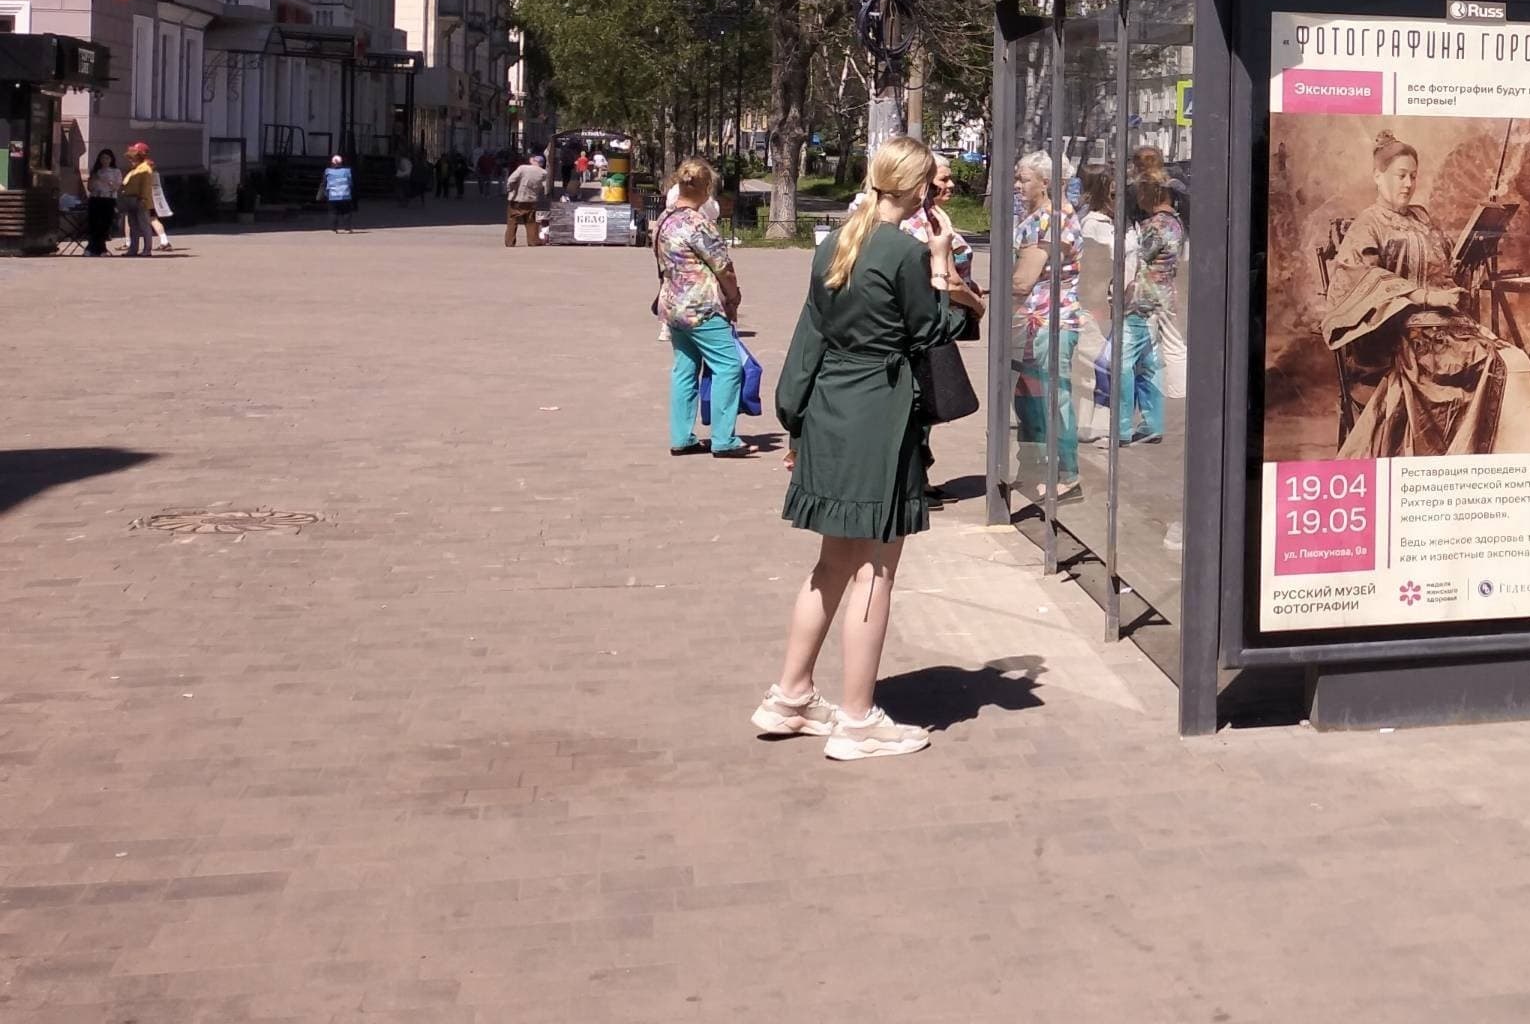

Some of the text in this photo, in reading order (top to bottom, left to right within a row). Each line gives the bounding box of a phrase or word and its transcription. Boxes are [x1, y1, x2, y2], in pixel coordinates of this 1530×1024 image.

[1468, 3, 1504, 18] Russ
[1294, 82, 1372, 97] Эксклюзив
[1407, 84, 1426, 93] все
[1428, 84, 1494, 95] фотографии
[1496, 85, 1526, 96] будут
[1407, 96, 1457, 107] впервые!
[1401, 466, 1468, 478] Реставрация
[1470, 465, 1527, 476] проведена
[1285, 473, 1367, 501] 19.04
[1401, 480, 1502, 493] фармацевтической
[1401, 497, 1444, 508] Рихтер»
[1455, 497, 1492, 507] рамках
[1285, 507, 1367, 535] 19.05
[1400, 512, 1450, 523] женского
[1400, 537, 1426, 547] Ведь
[1428, 536, 1472, 546] женское
[1474, 535, 1524, 545] здоровье
[1283, 551, 1298, 561] ул.
[1400, 554, 1418, 563] как
[1429, 551, 1484, 561] известные
[1273, 582, 1376, 601] РУССКИЙ МУЗЕЙ
[1273, 600, 1359, 615] ФОТОГРАФИИ
